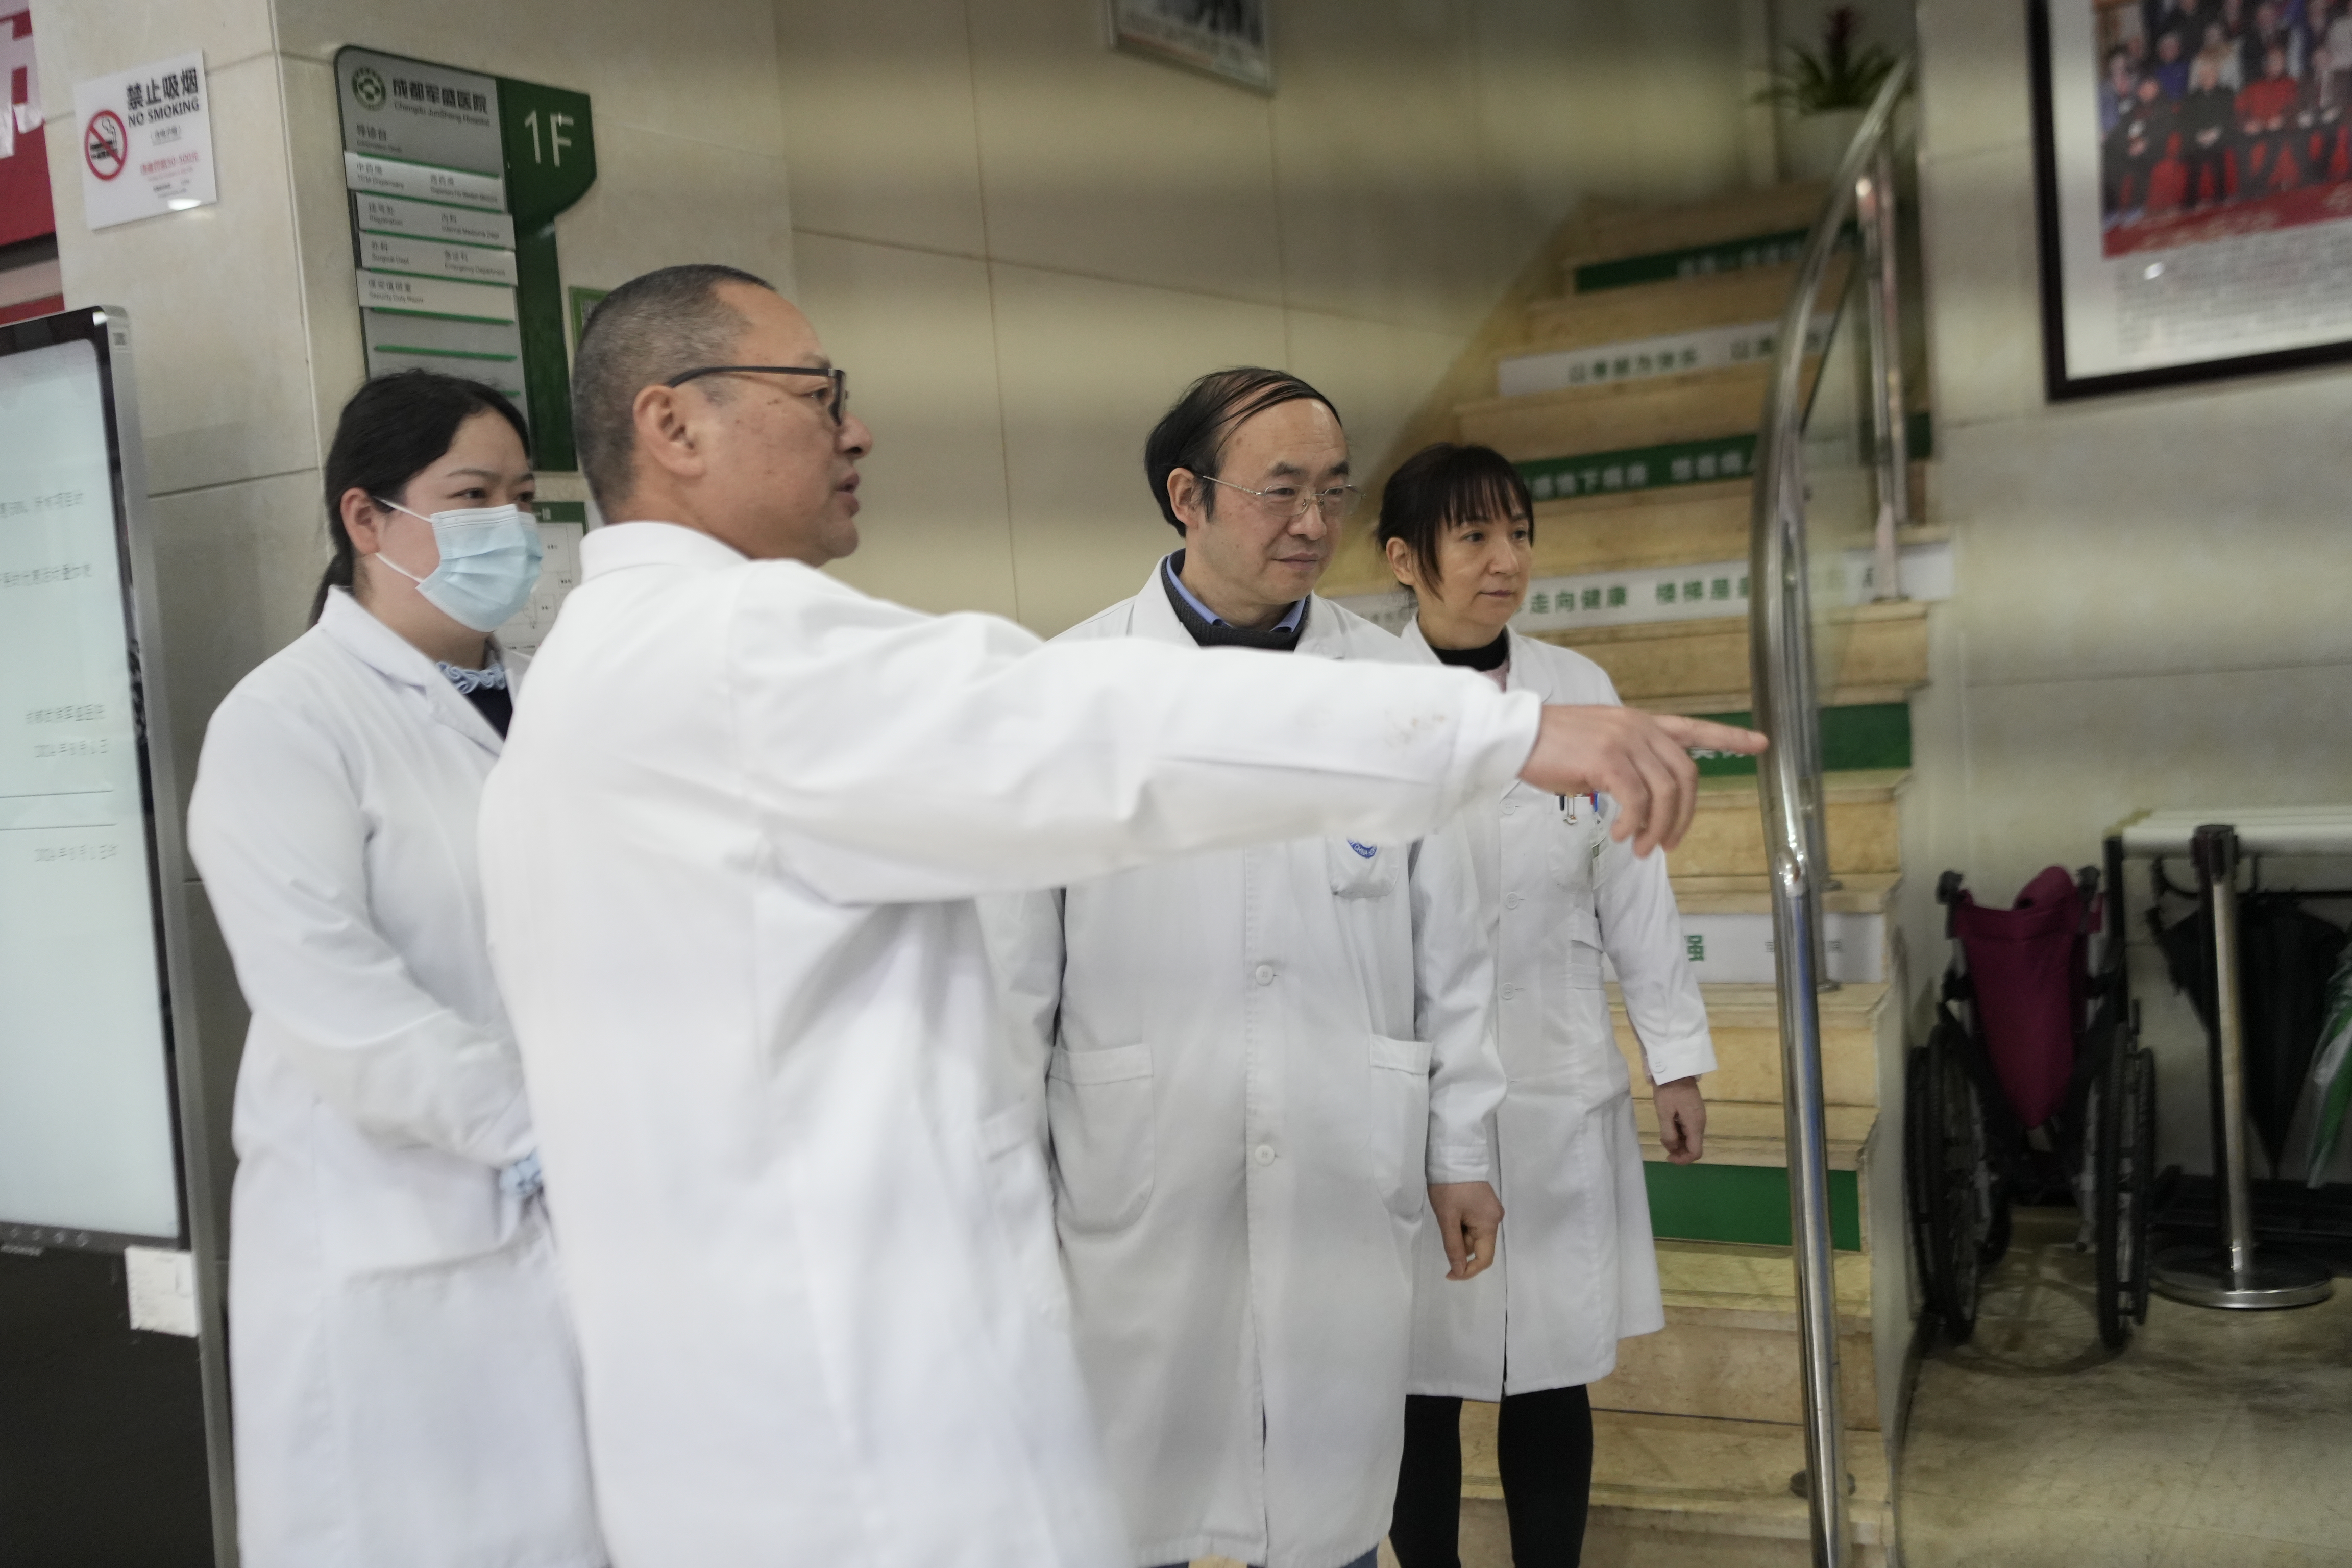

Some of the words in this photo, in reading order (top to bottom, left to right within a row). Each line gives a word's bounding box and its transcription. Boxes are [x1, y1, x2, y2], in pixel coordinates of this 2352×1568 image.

[126, 67, 199, 111] 禁止吸烟
[128, 111, 144, 128] NO
[148, 95, 200, 124] SMOKING
[524, 109, 574, 168] 1F
[1519, 585, 1628, 615] 走向健康
